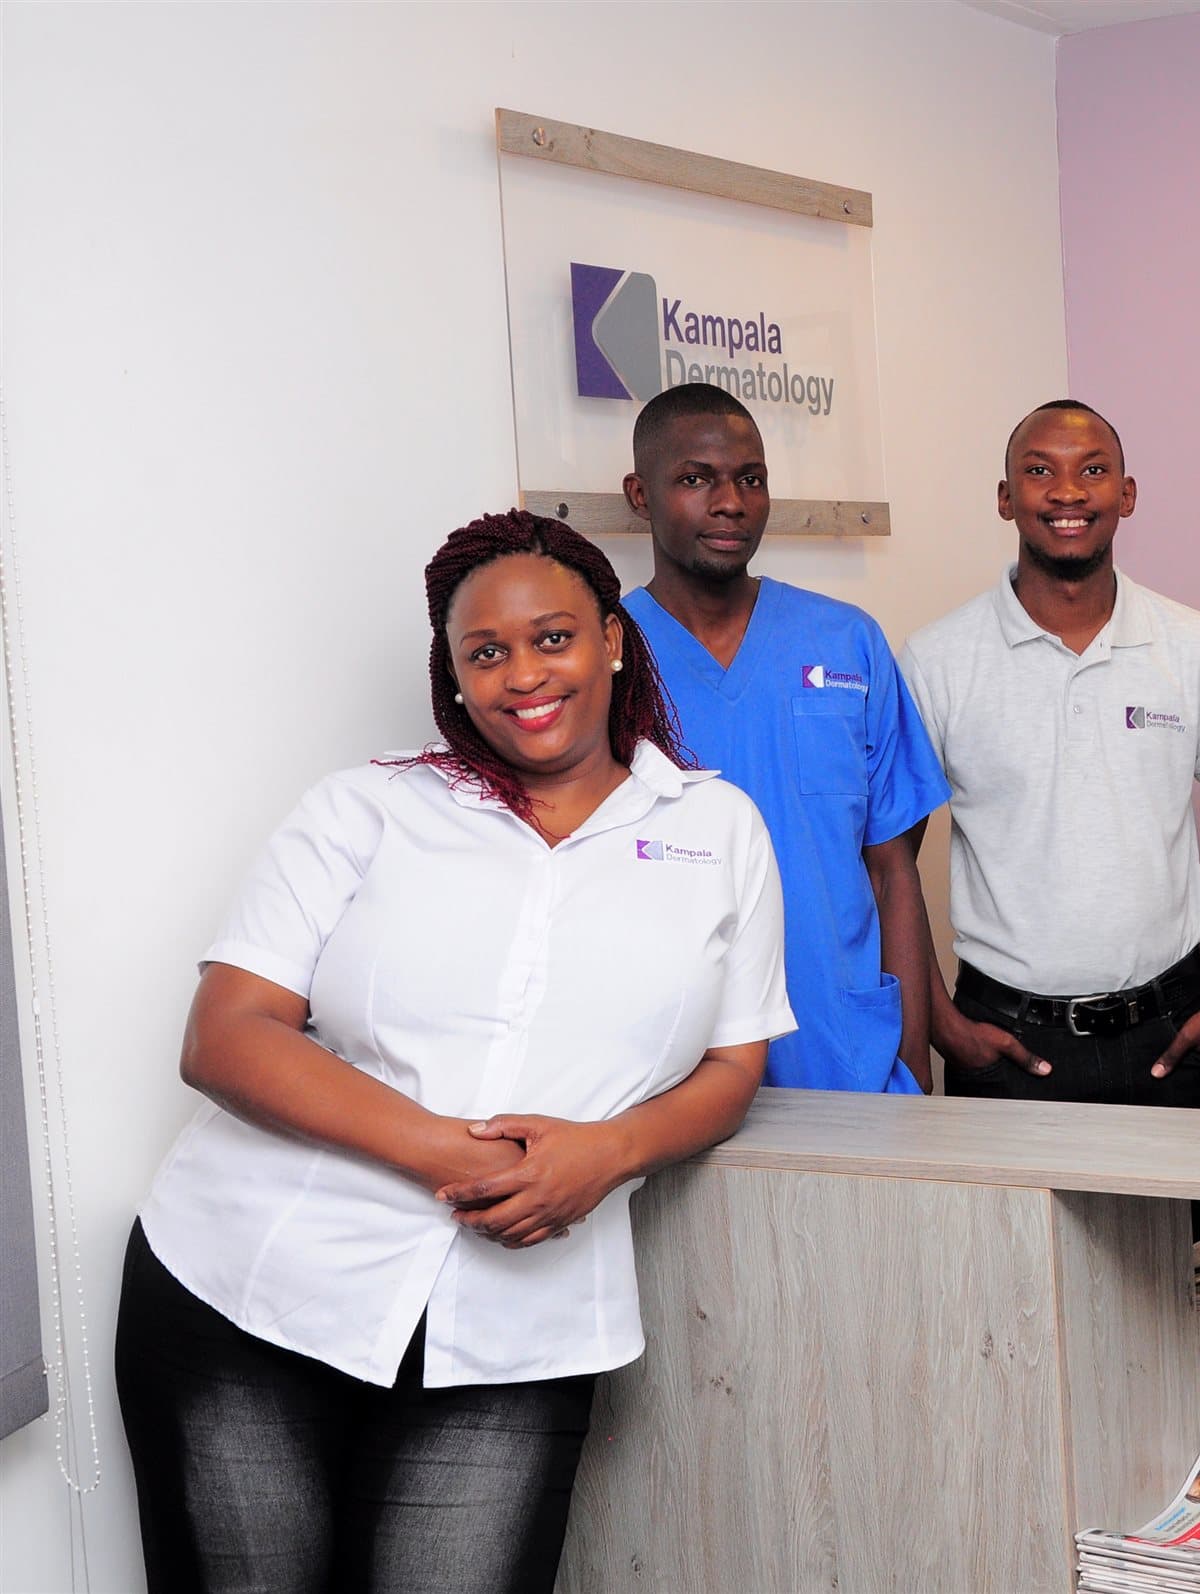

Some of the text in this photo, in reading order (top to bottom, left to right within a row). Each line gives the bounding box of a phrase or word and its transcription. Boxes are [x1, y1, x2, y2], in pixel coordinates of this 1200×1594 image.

[662, 298, 782, 359] Kampala
[665, 349, 834, 416] Dermatology
[825, 671, 862, 683] Kampala
[1146, 711, 1180, 723] Kampala
[665, 843, 712, 857] Kampala
[666, 853, 722, 865] Dermatology
